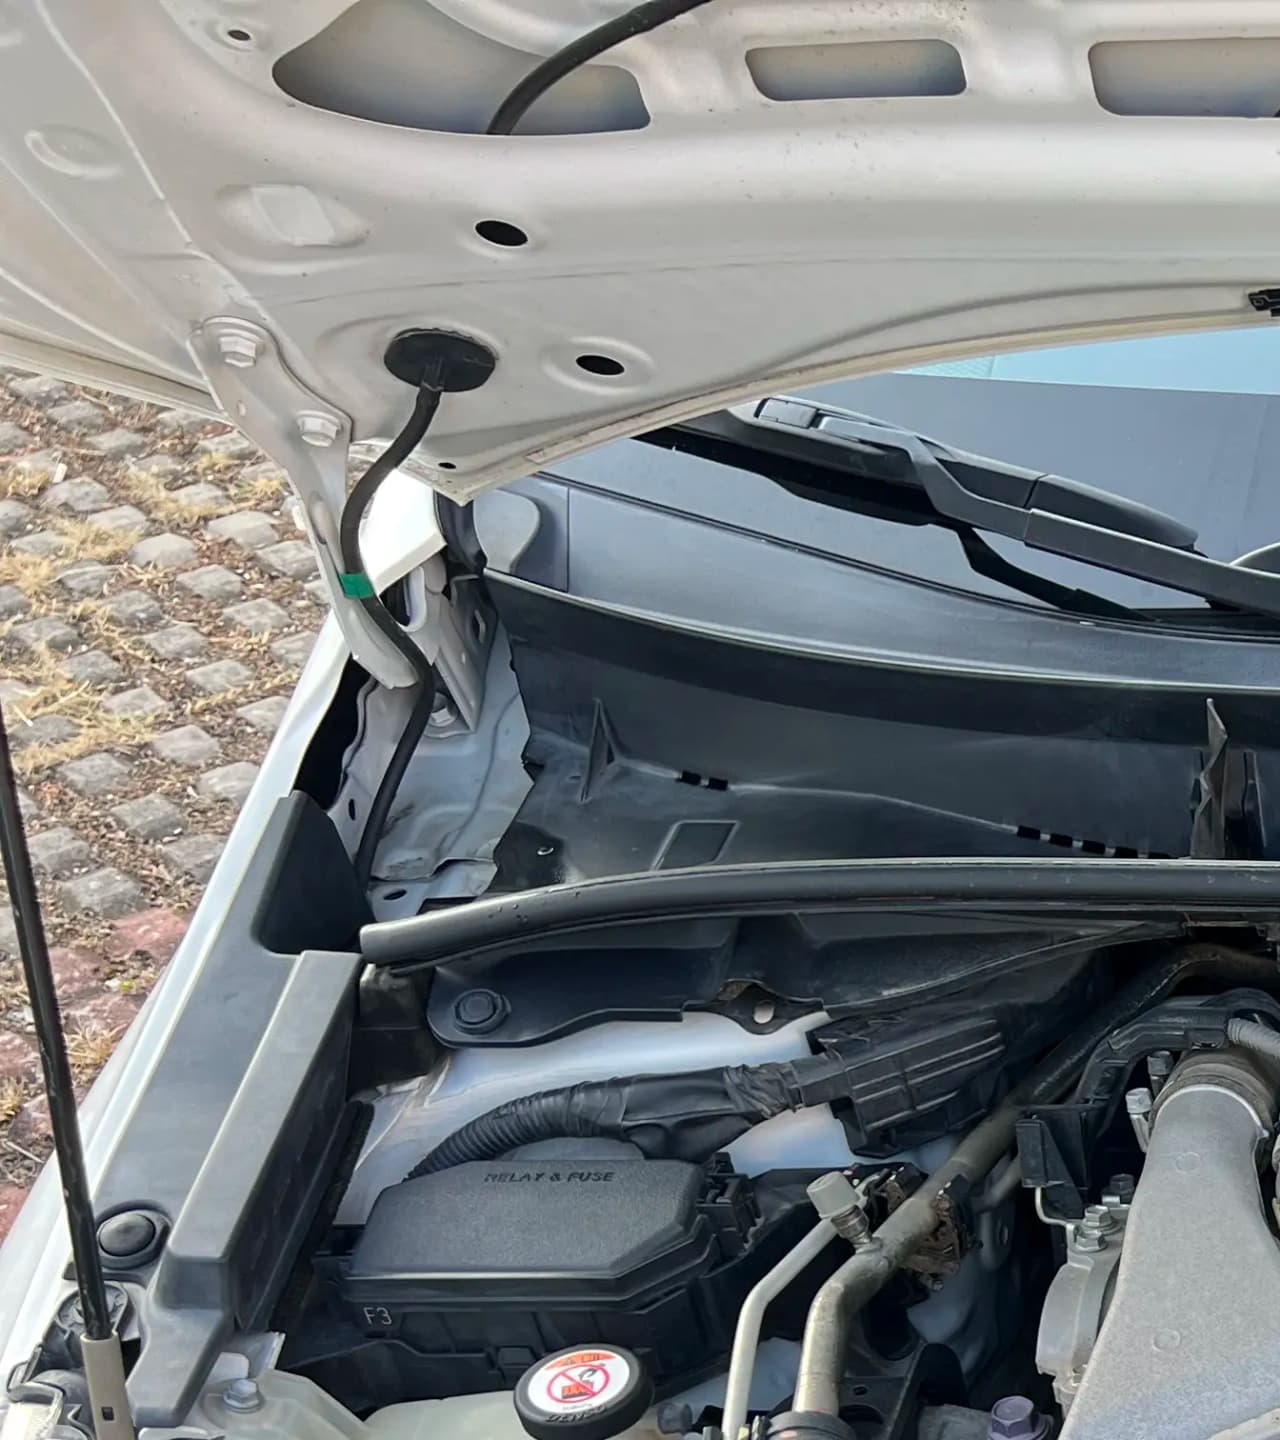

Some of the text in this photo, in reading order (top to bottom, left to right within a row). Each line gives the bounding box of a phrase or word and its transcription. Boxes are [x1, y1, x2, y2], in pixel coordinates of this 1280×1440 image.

[484, 1170, 616, 1183] RELAY & FUSE
[363, 1307, 392, 1327] F3
